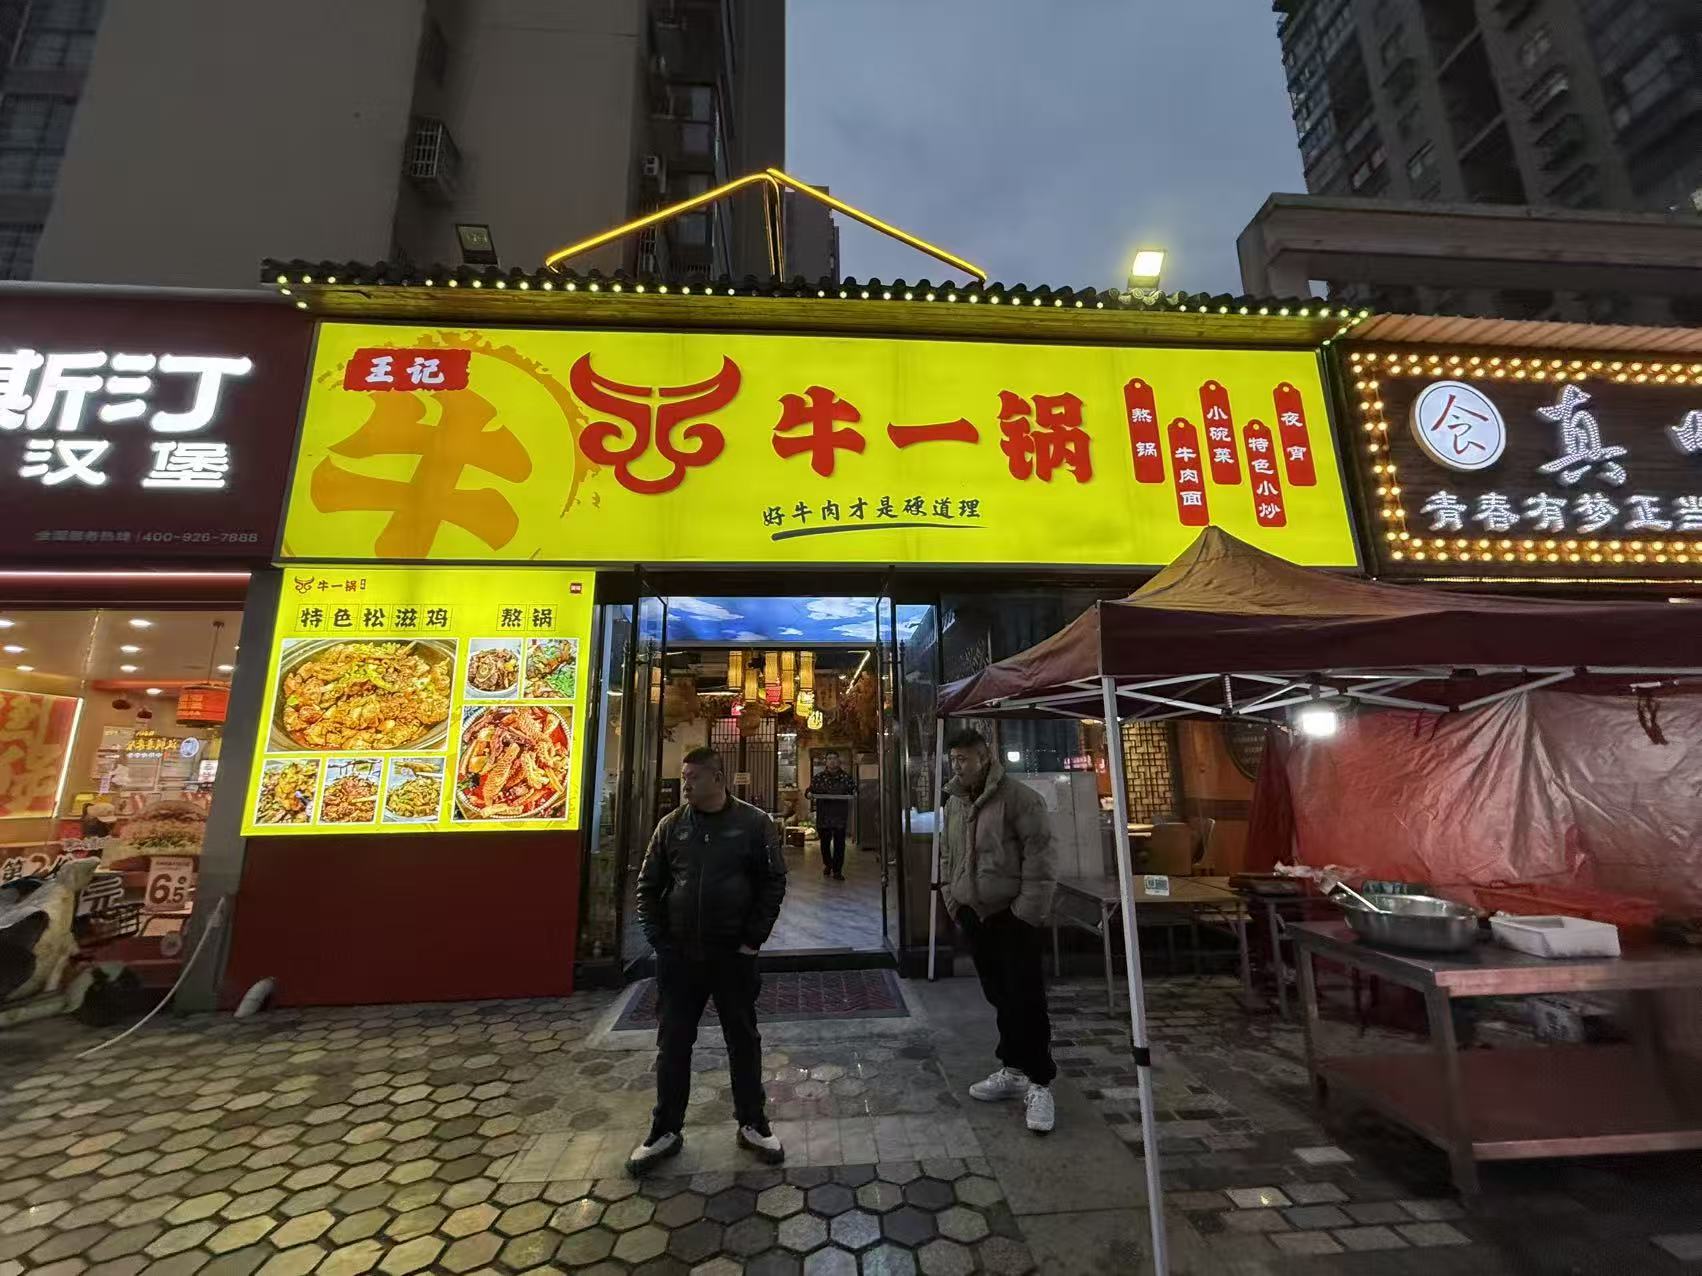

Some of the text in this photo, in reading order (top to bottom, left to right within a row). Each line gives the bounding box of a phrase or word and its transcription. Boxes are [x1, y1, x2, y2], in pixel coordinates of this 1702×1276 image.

[364, 355, 446, 385] 王记
[771, 385, 1094, 484] 牛一锅
[1131, 408, 1158, 458] 熬锅
[1206, 405, 1235, 464] 小碗菜
[1280, 411, 1307, 462] 夜宵
[19, 438, 230, 488] 汉堡
[1174, 446, 1203, 507] 牛肉面
[1248, 437, 1281, 519] 特色小炒
[762, 495, 982, 528] 好牛肉才是硬道理
[316, 578, 357, 593] 牛一锅
[300, 606, 448, 629] 特色松滋鸡
[500, 608, 552, 628] 熬锅
